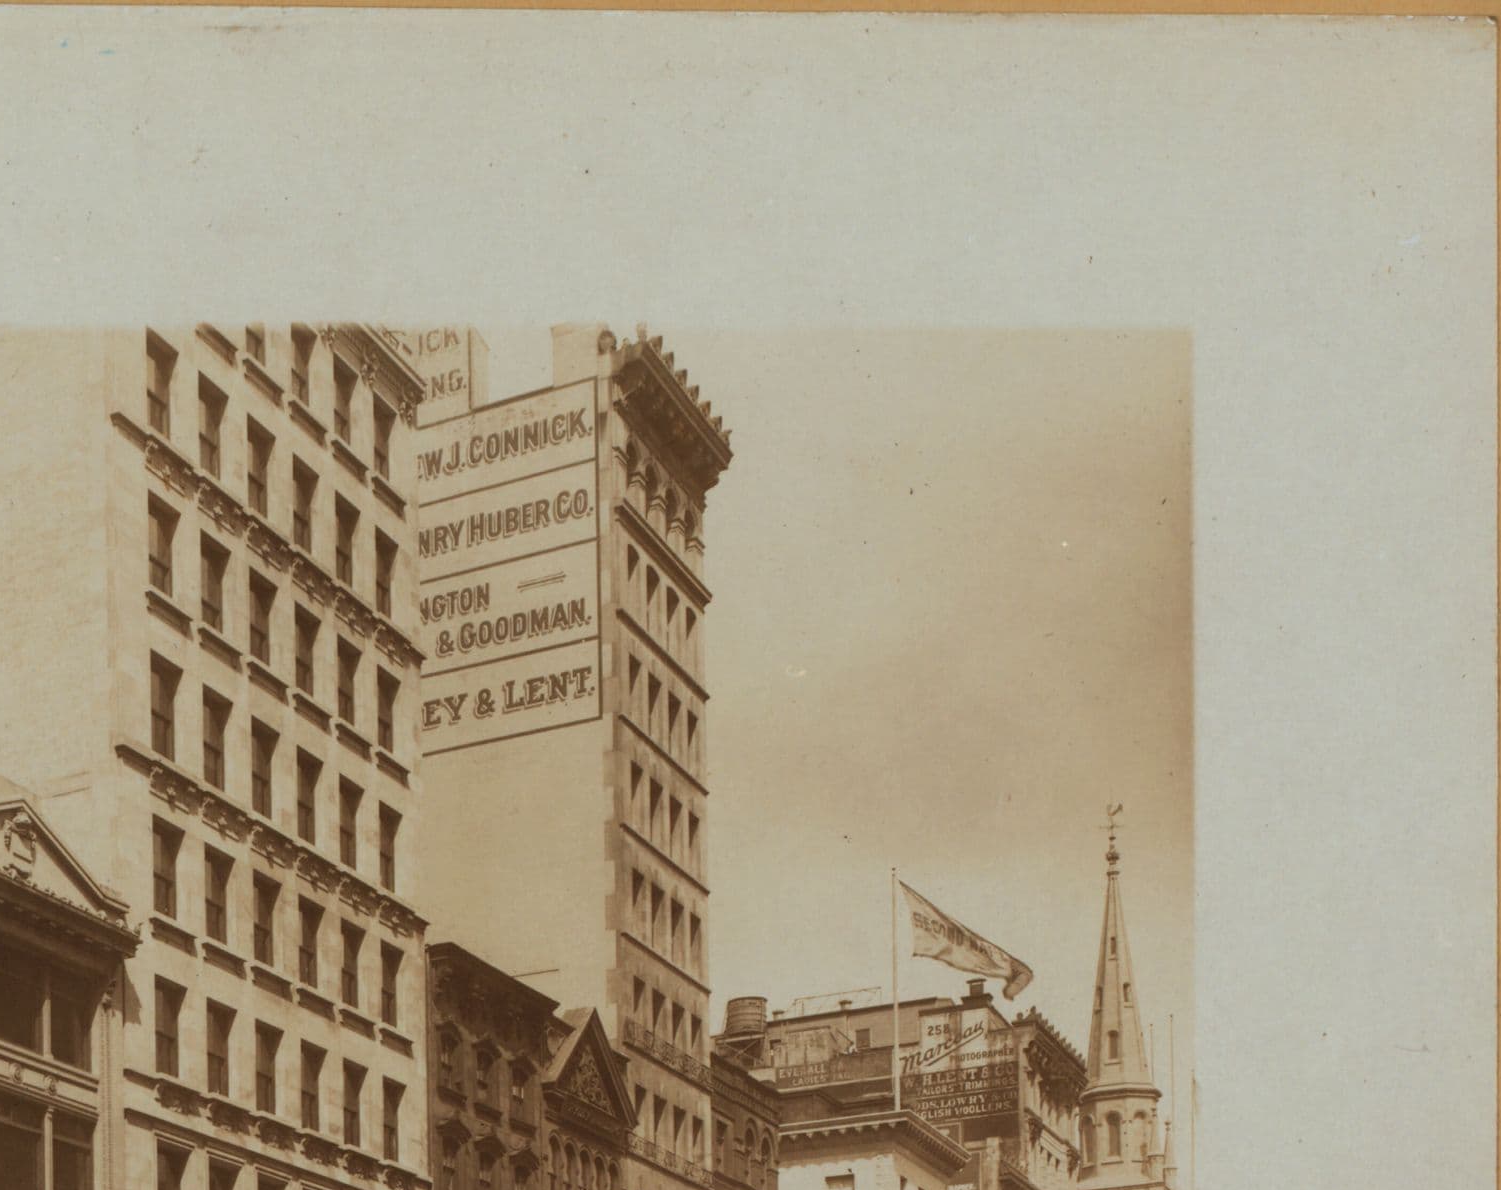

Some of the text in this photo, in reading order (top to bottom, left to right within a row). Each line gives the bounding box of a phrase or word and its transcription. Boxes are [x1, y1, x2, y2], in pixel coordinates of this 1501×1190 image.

[468, 499, 551, 548] HUBER
[554, 488, 594, 525] CO.
[436, 597, 593, 658] & GOODMAN.
[422, 665, 596, 731] EY & LENT.
[927, 1023, 951, 1037] 258
